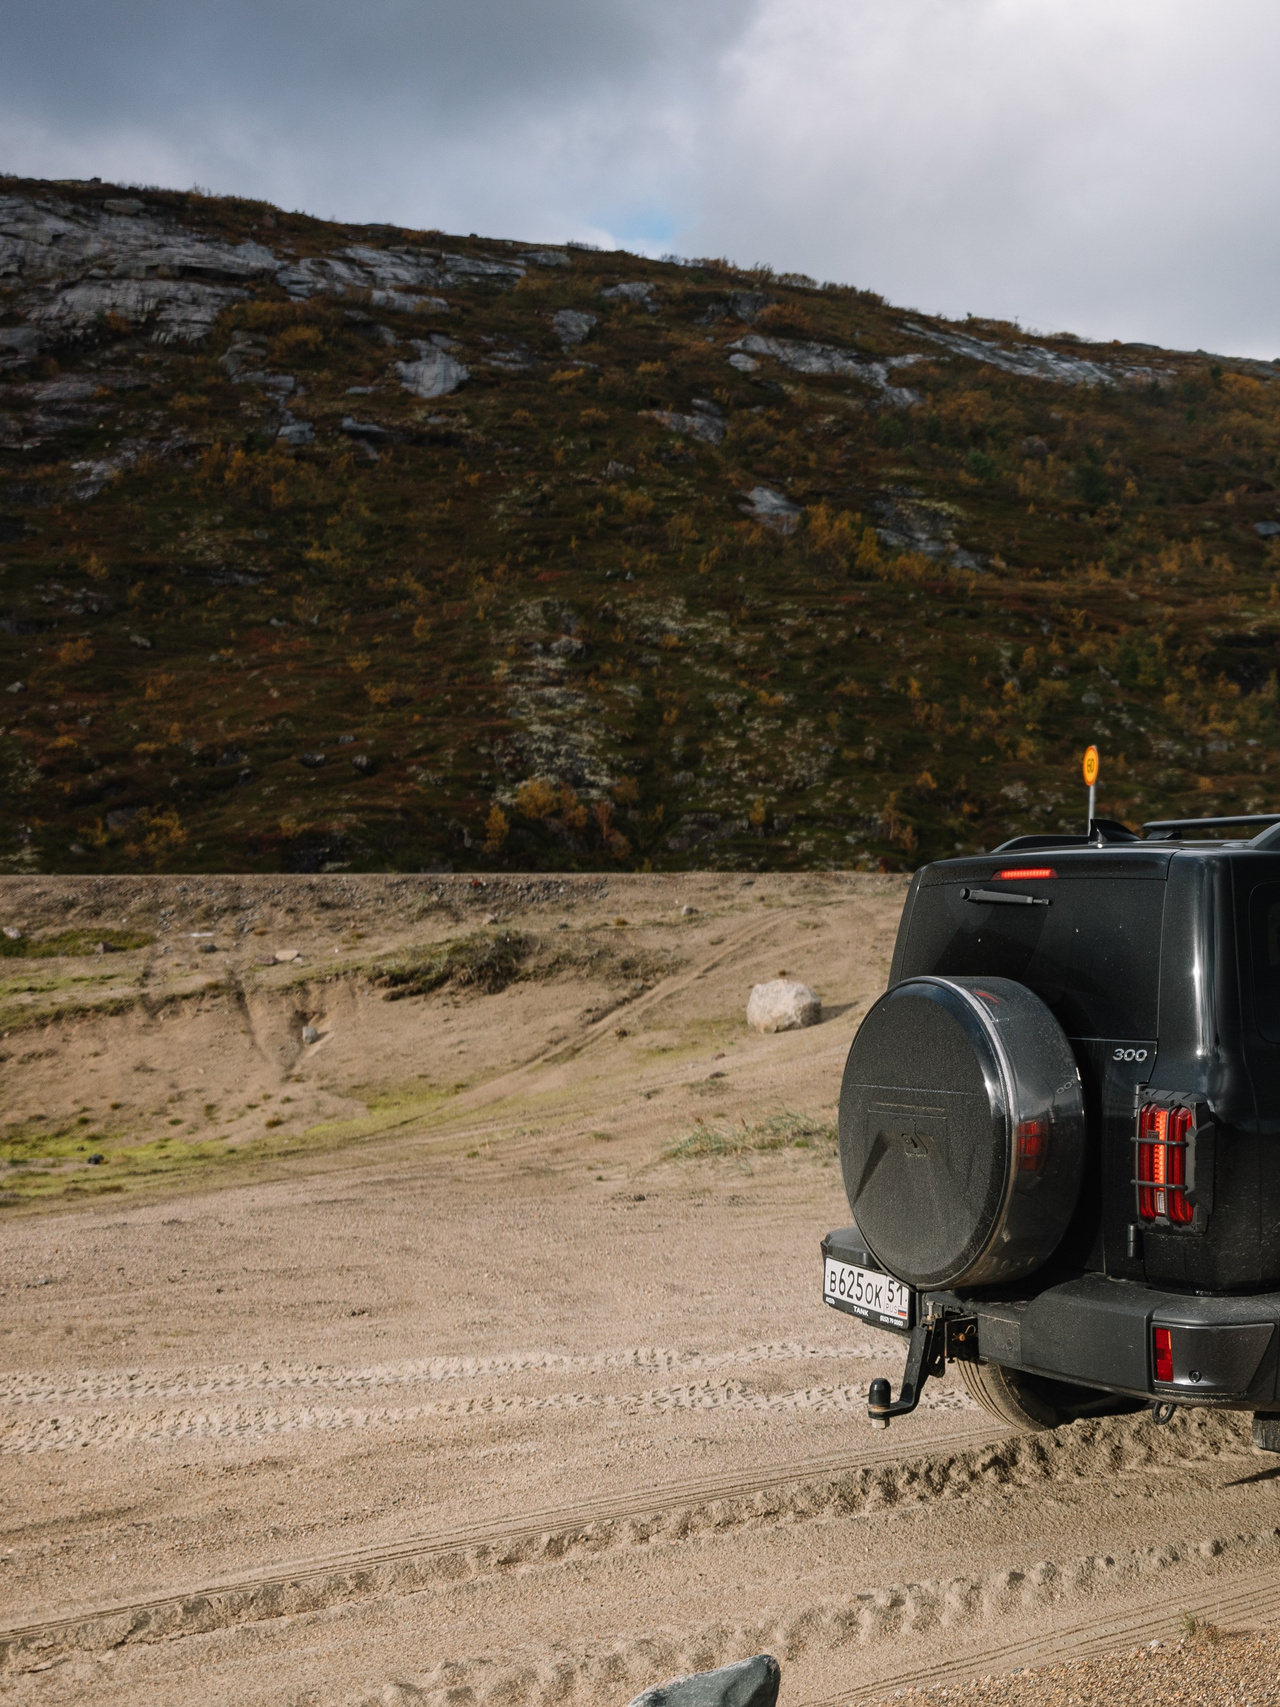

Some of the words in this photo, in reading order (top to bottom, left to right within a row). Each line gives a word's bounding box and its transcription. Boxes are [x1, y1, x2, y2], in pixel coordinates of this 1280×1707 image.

[1112, 1048, 1148, 1061] 300
[887, 1280, 904, 1306] 51
[853, 1306, 868, 1316] TANK
[886, 1303, 897, 1314] RUS
